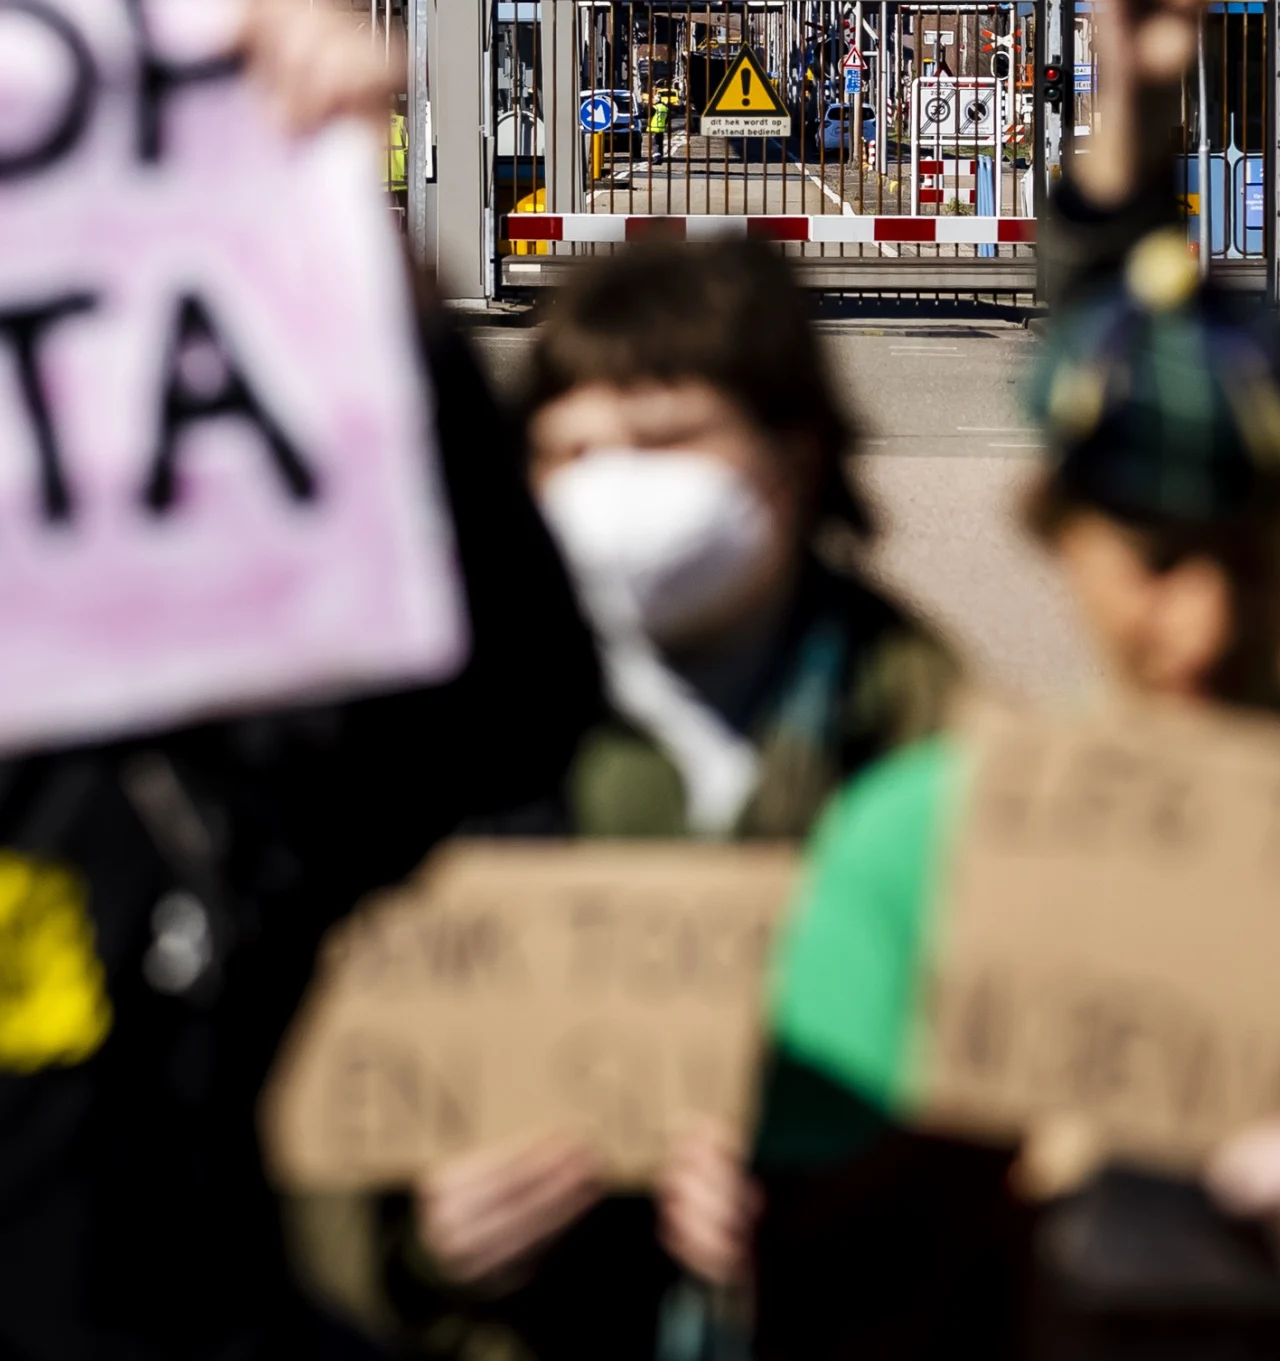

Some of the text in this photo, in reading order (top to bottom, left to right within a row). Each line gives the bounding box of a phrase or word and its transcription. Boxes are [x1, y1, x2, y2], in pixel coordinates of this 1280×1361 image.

[710, 118, 722, 126] dit
[724, 118, 740, 126] hek
[743, 118, 768, 126] wordt
[711, 128, 781, 136] afstand bediend
